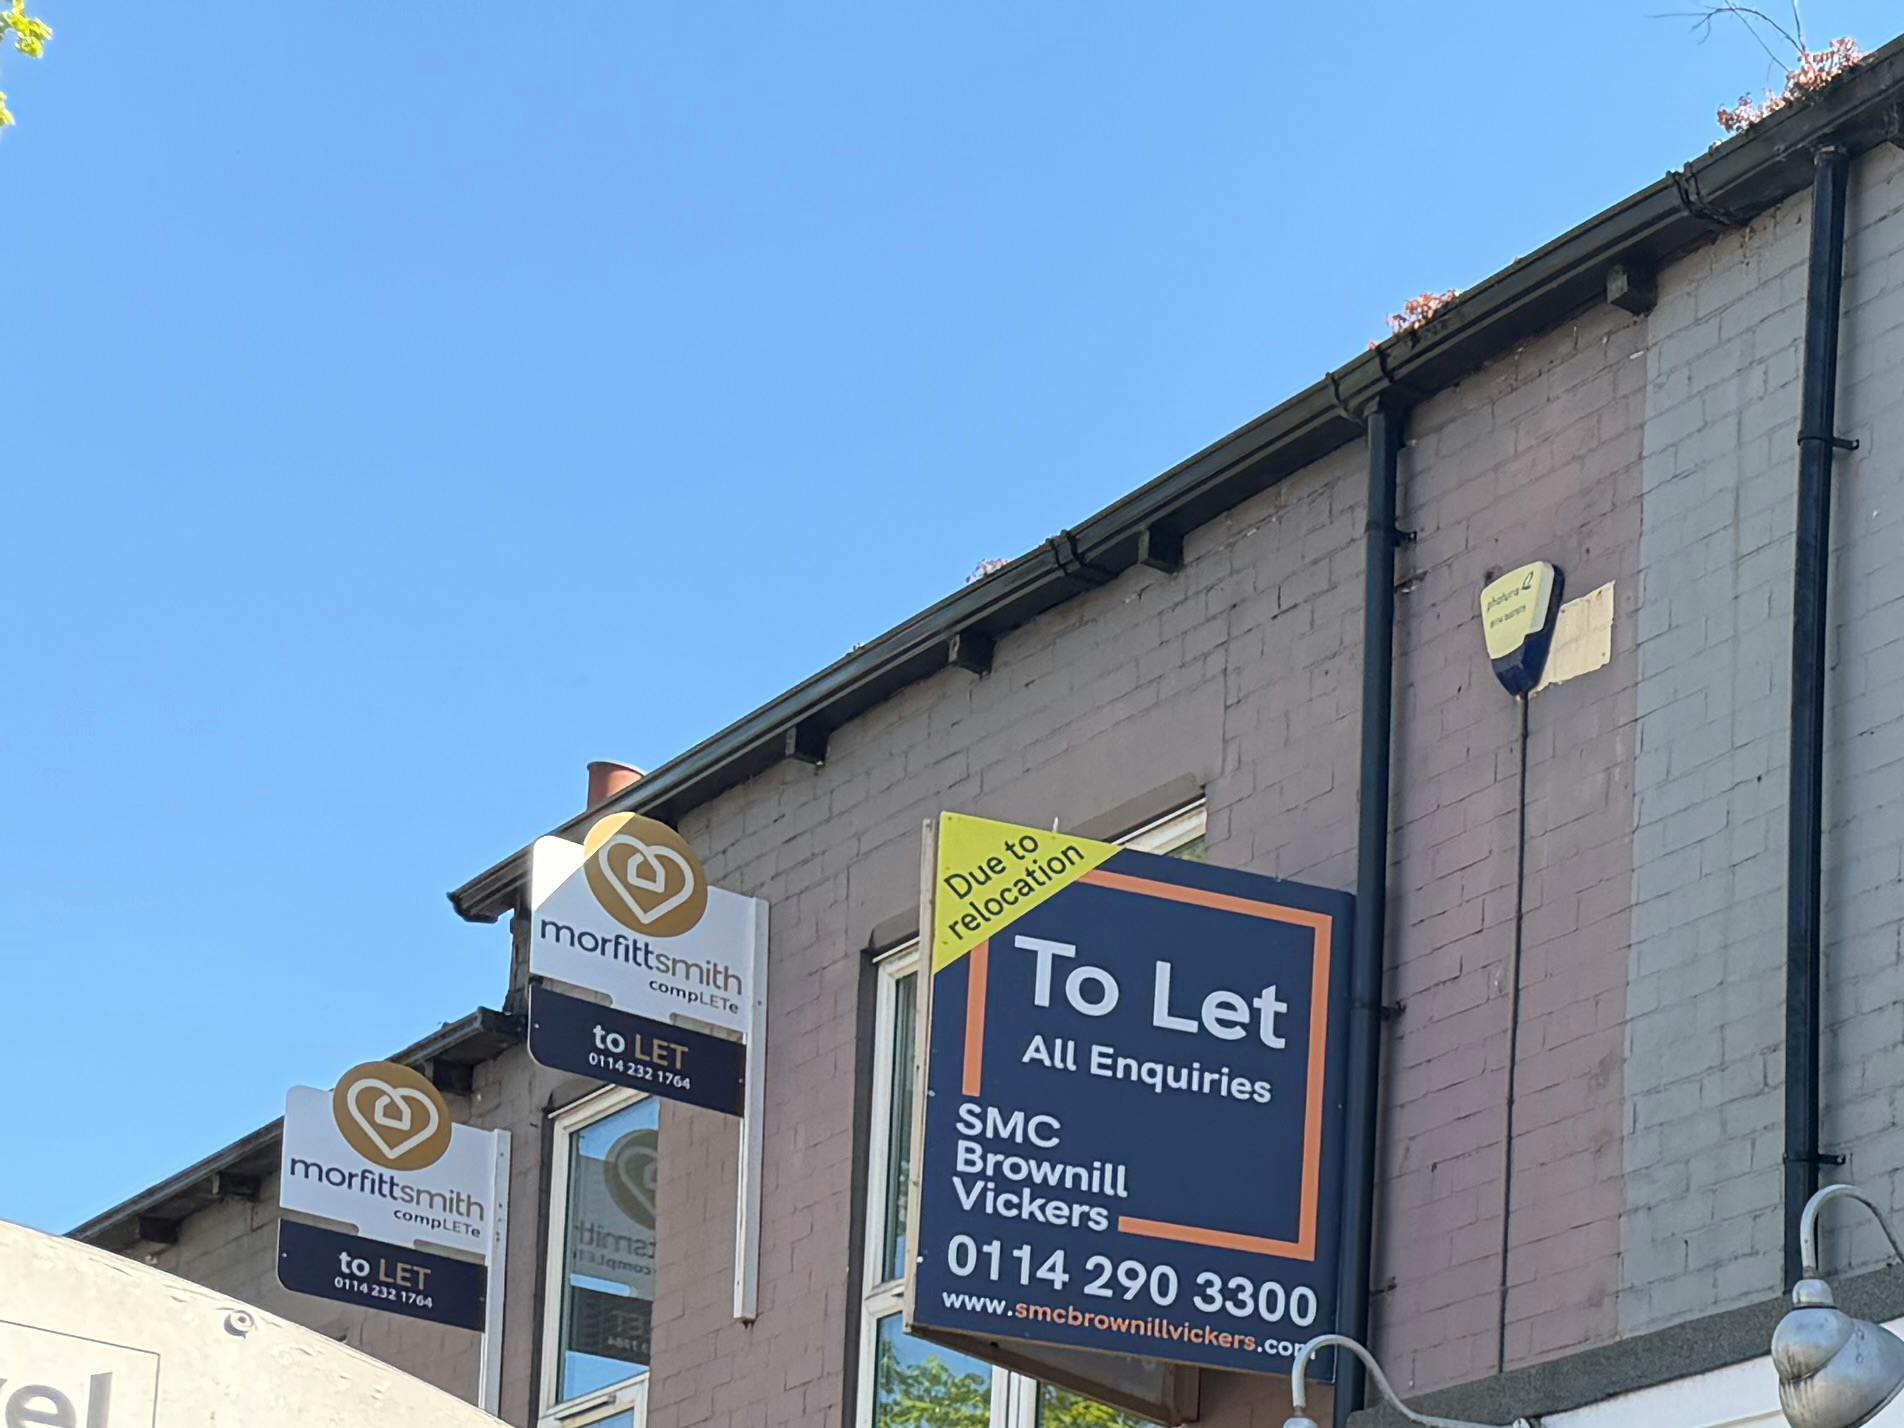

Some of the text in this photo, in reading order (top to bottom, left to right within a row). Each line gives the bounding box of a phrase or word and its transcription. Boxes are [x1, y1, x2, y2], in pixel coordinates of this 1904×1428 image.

[944, 832, 1041, 901] Due to
[947, 843, 1085, 942] relocation
[540, 919, 743, 996] morfittsmith
[1014, 934, 1288, 1049] To Let
[589, 1053, 691, 1090] 0114 232 1764
[593, 1024, 689, 1070] to LET
[1022, 1034, 1272, 1104] All Enquiries
[955, 1102, 1061, 1148] SMC
[290, 1157, 485, 1222] morfittsmith
[956, 1140, 1128, 1198] Brownill
[952, 1177, 1109, 1231] Vickers
[334, 1276, 433, 1309] 0114 232 1764
[338, 1251, 431, 1291] to LET
[947, 1234, 1317, 1328] 0114 290 3300
